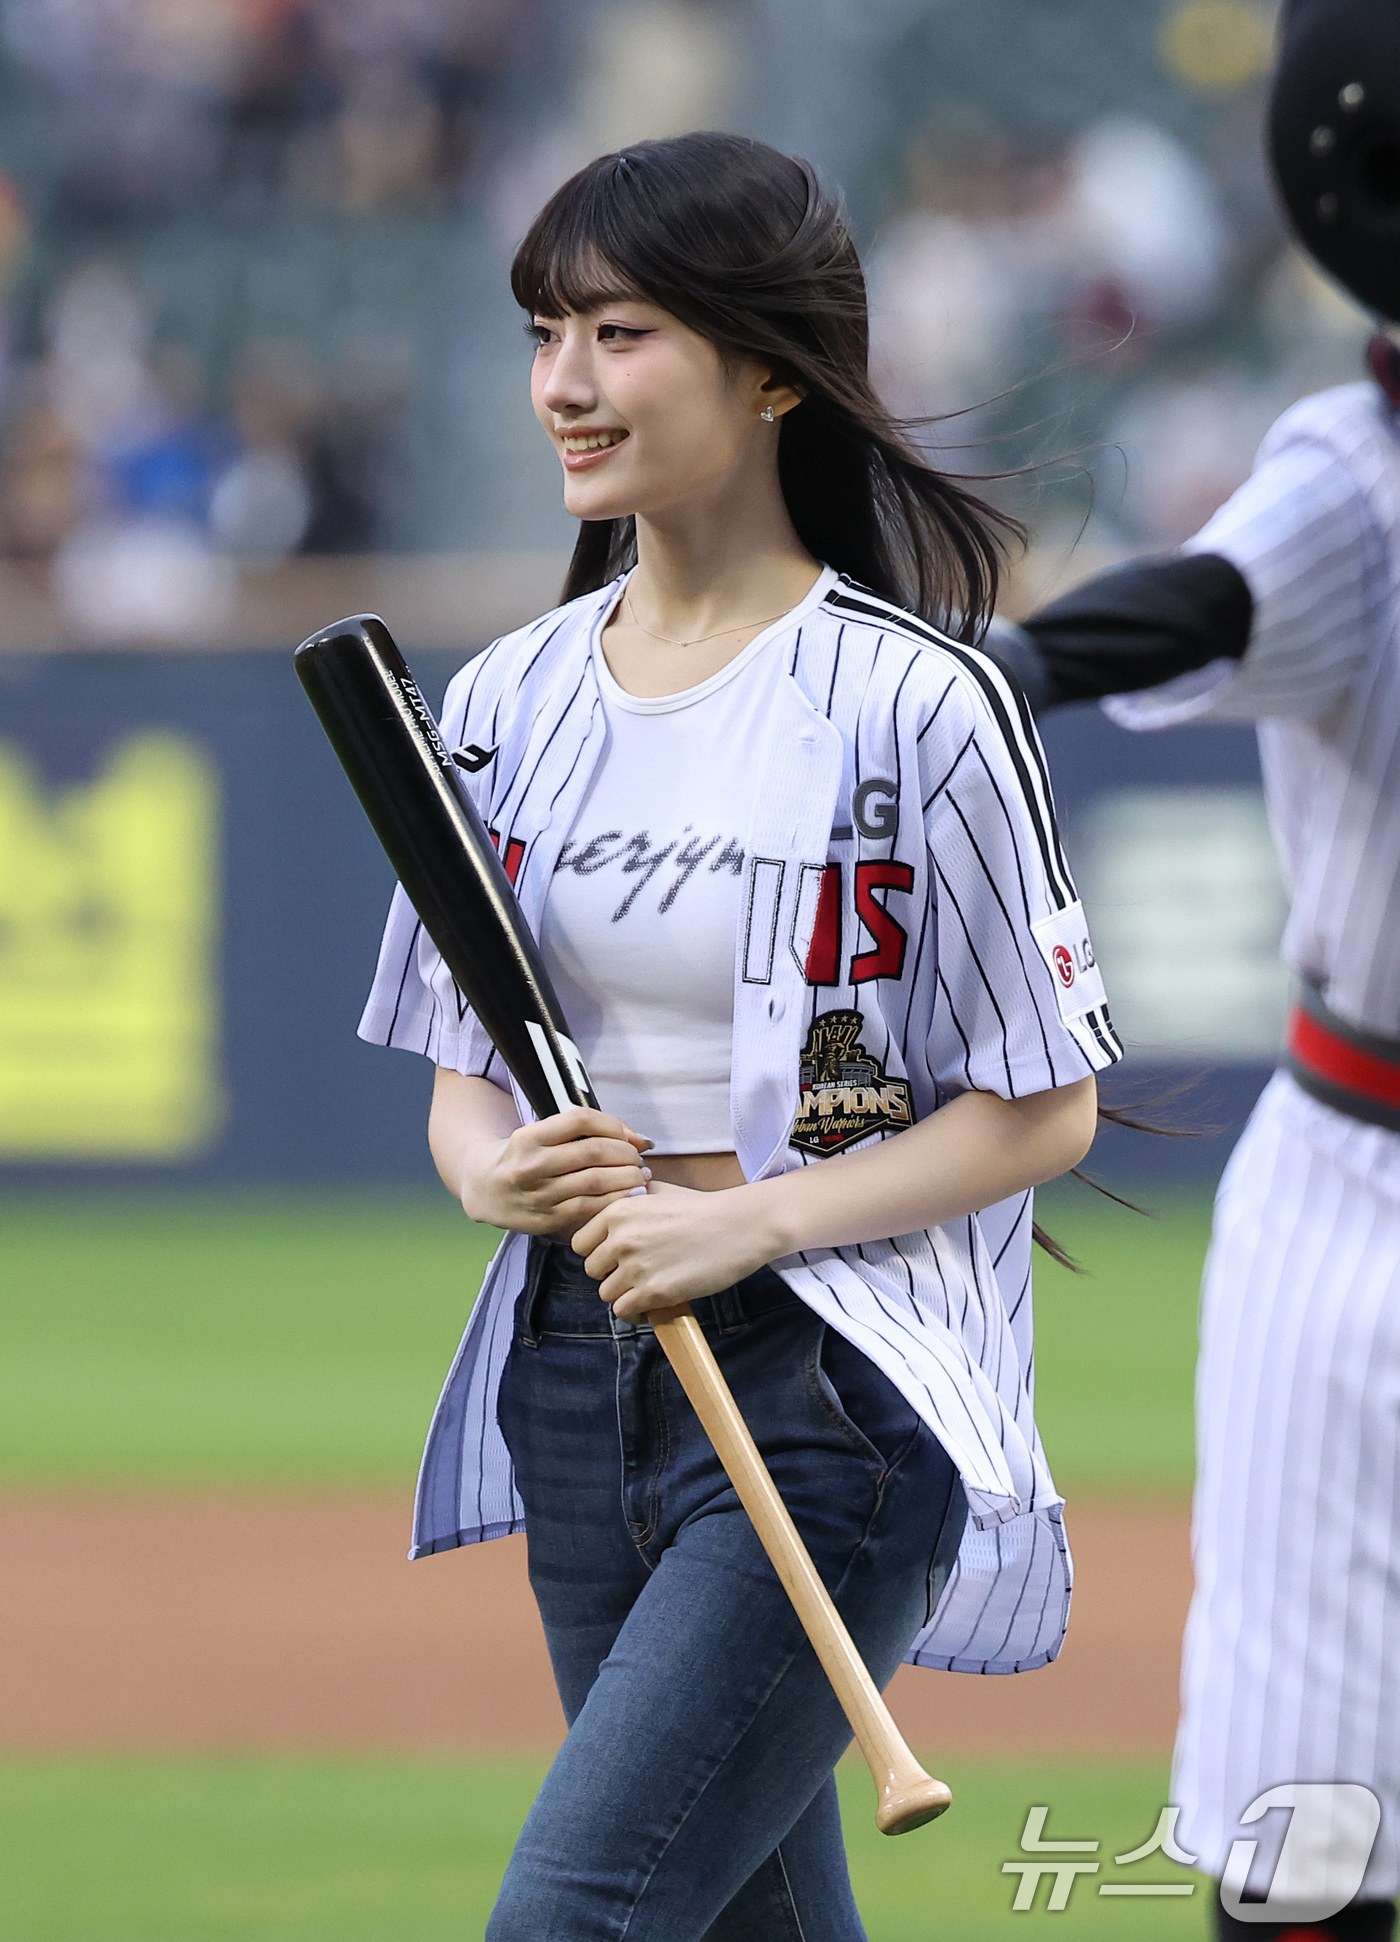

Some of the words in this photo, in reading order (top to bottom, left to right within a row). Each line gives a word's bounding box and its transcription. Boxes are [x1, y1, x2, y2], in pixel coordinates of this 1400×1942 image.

[400, 677, 453, 767] MSG-MT47
[836, 1079, 858, 1089] SERIES
[809, 1136, 820, 1144] LG
